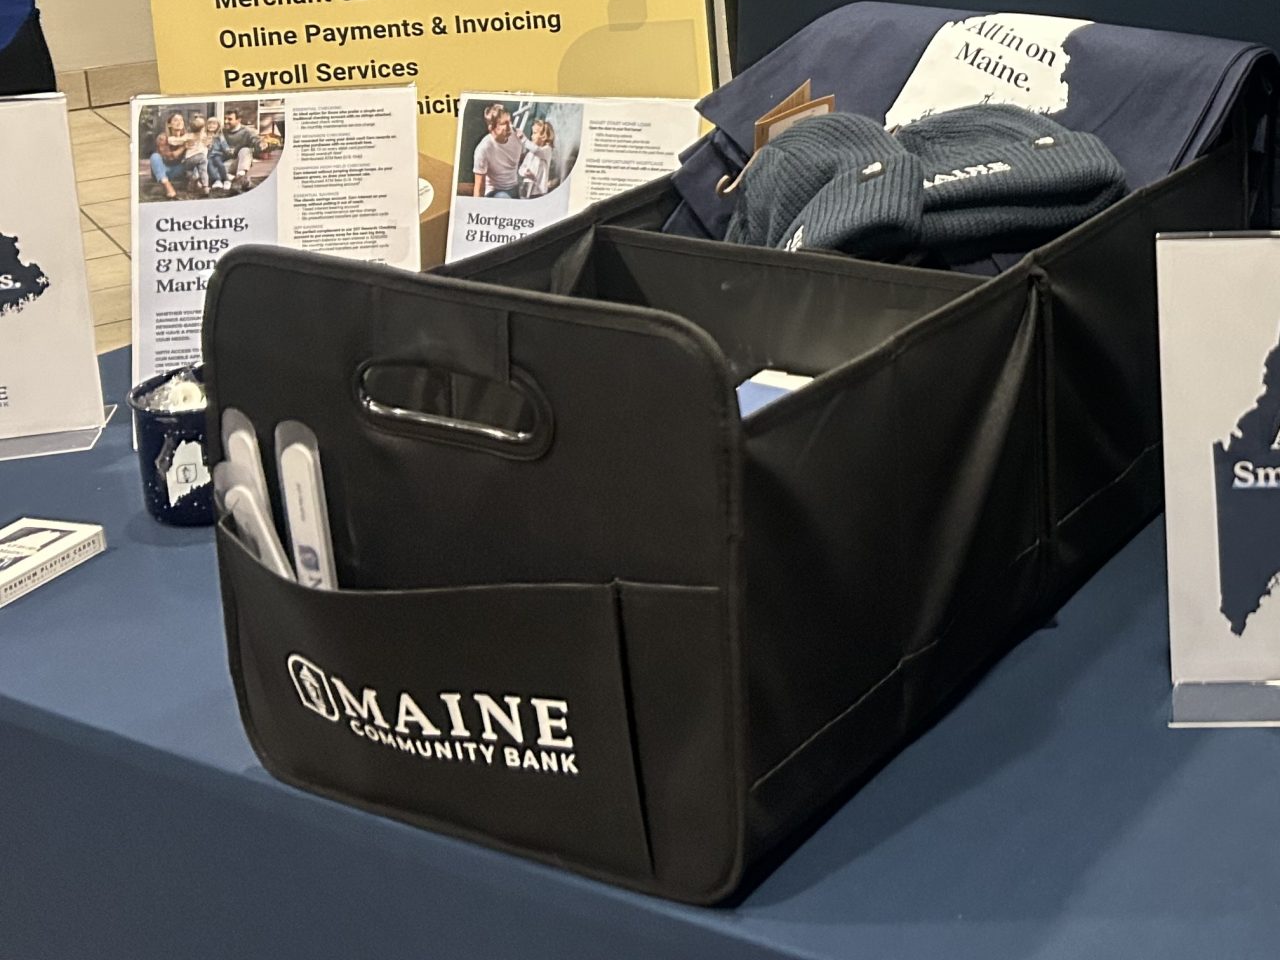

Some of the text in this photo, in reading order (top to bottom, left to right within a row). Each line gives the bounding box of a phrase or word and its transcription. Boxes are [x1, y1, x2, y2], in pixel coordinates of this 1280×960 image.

[219, 10, 561, 49] Online Payments & Invoicing
[966, 20, 1057, 67] All in on
[224, 59, 418, 92] Payroll Services
[955, 41, 1031, 92] Maine.
[156, 215, 249, 233] Checking,
[465, 229, 477, 242] &
[467, 213, 535, 230] Mortgages
[156, 236, 229, 253] Savings
[156, 258, 217, 273] & Mon
[4, 539, 96, 593] PREMIUM PLAYING CARDS
[331, 677, 573, 749] MAINE
[350, 718, 579, 774] COMMUNITY BANK
